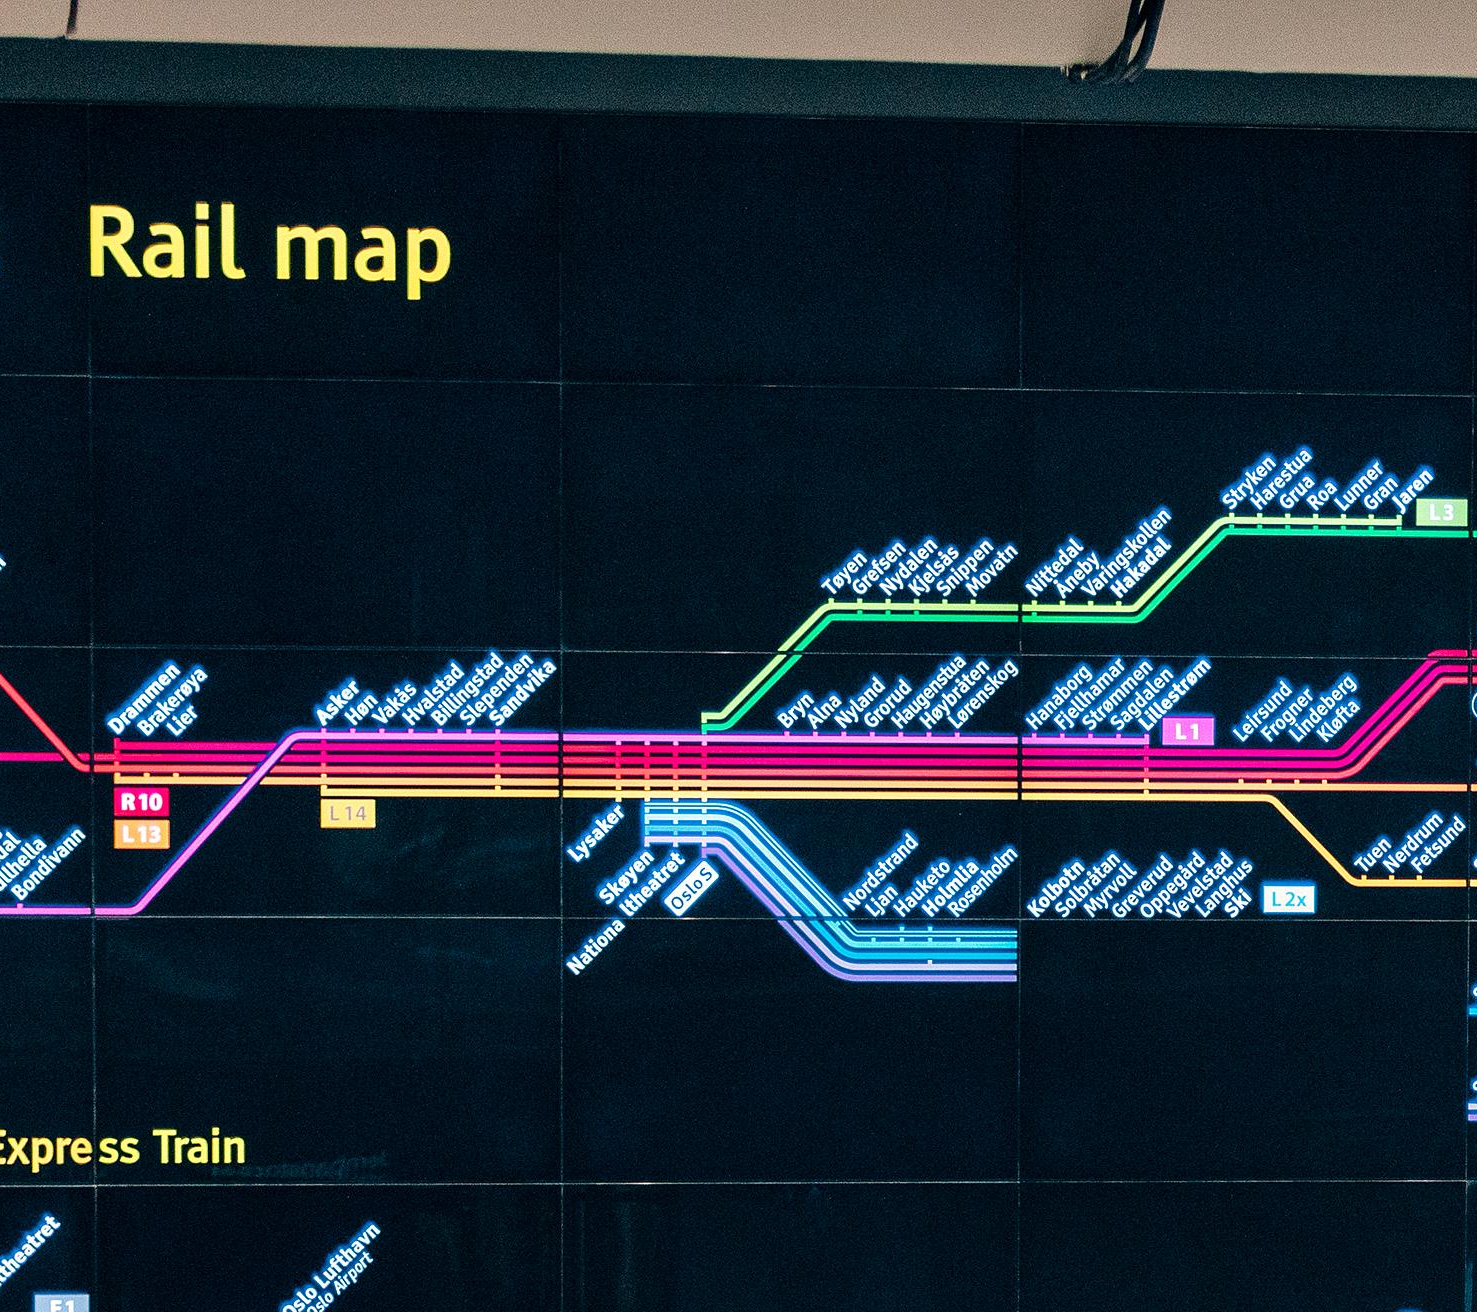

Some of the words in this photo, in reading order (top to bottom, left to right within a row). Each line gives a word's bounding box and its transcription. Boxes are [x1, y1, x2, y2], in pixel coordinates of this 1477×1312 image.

[90, 203, 245, 279] Rail
[277, 226, 450, 300] map
[1224, 454, 1276, 510] Stryken
[1391, 468, 1434, 514] Jaren
[108, 665, 180, 734] Drammen
[137, 670, 207, 735] Brakerøya
[489, 662, 556, 725] Sandvika
[948, 661, 1018, 728] Lørenskog
[1138, 661, 1211, 730] Lillestrøm
[12, 830, 85, 900] Bondivann
[567, 806, 625, 863] Lysaker
[948, 849, 1017, 917] Rosenholm
[1028, 863, 1084, 917] Kolbotn
[153, 1127, 244, 1163] Train
